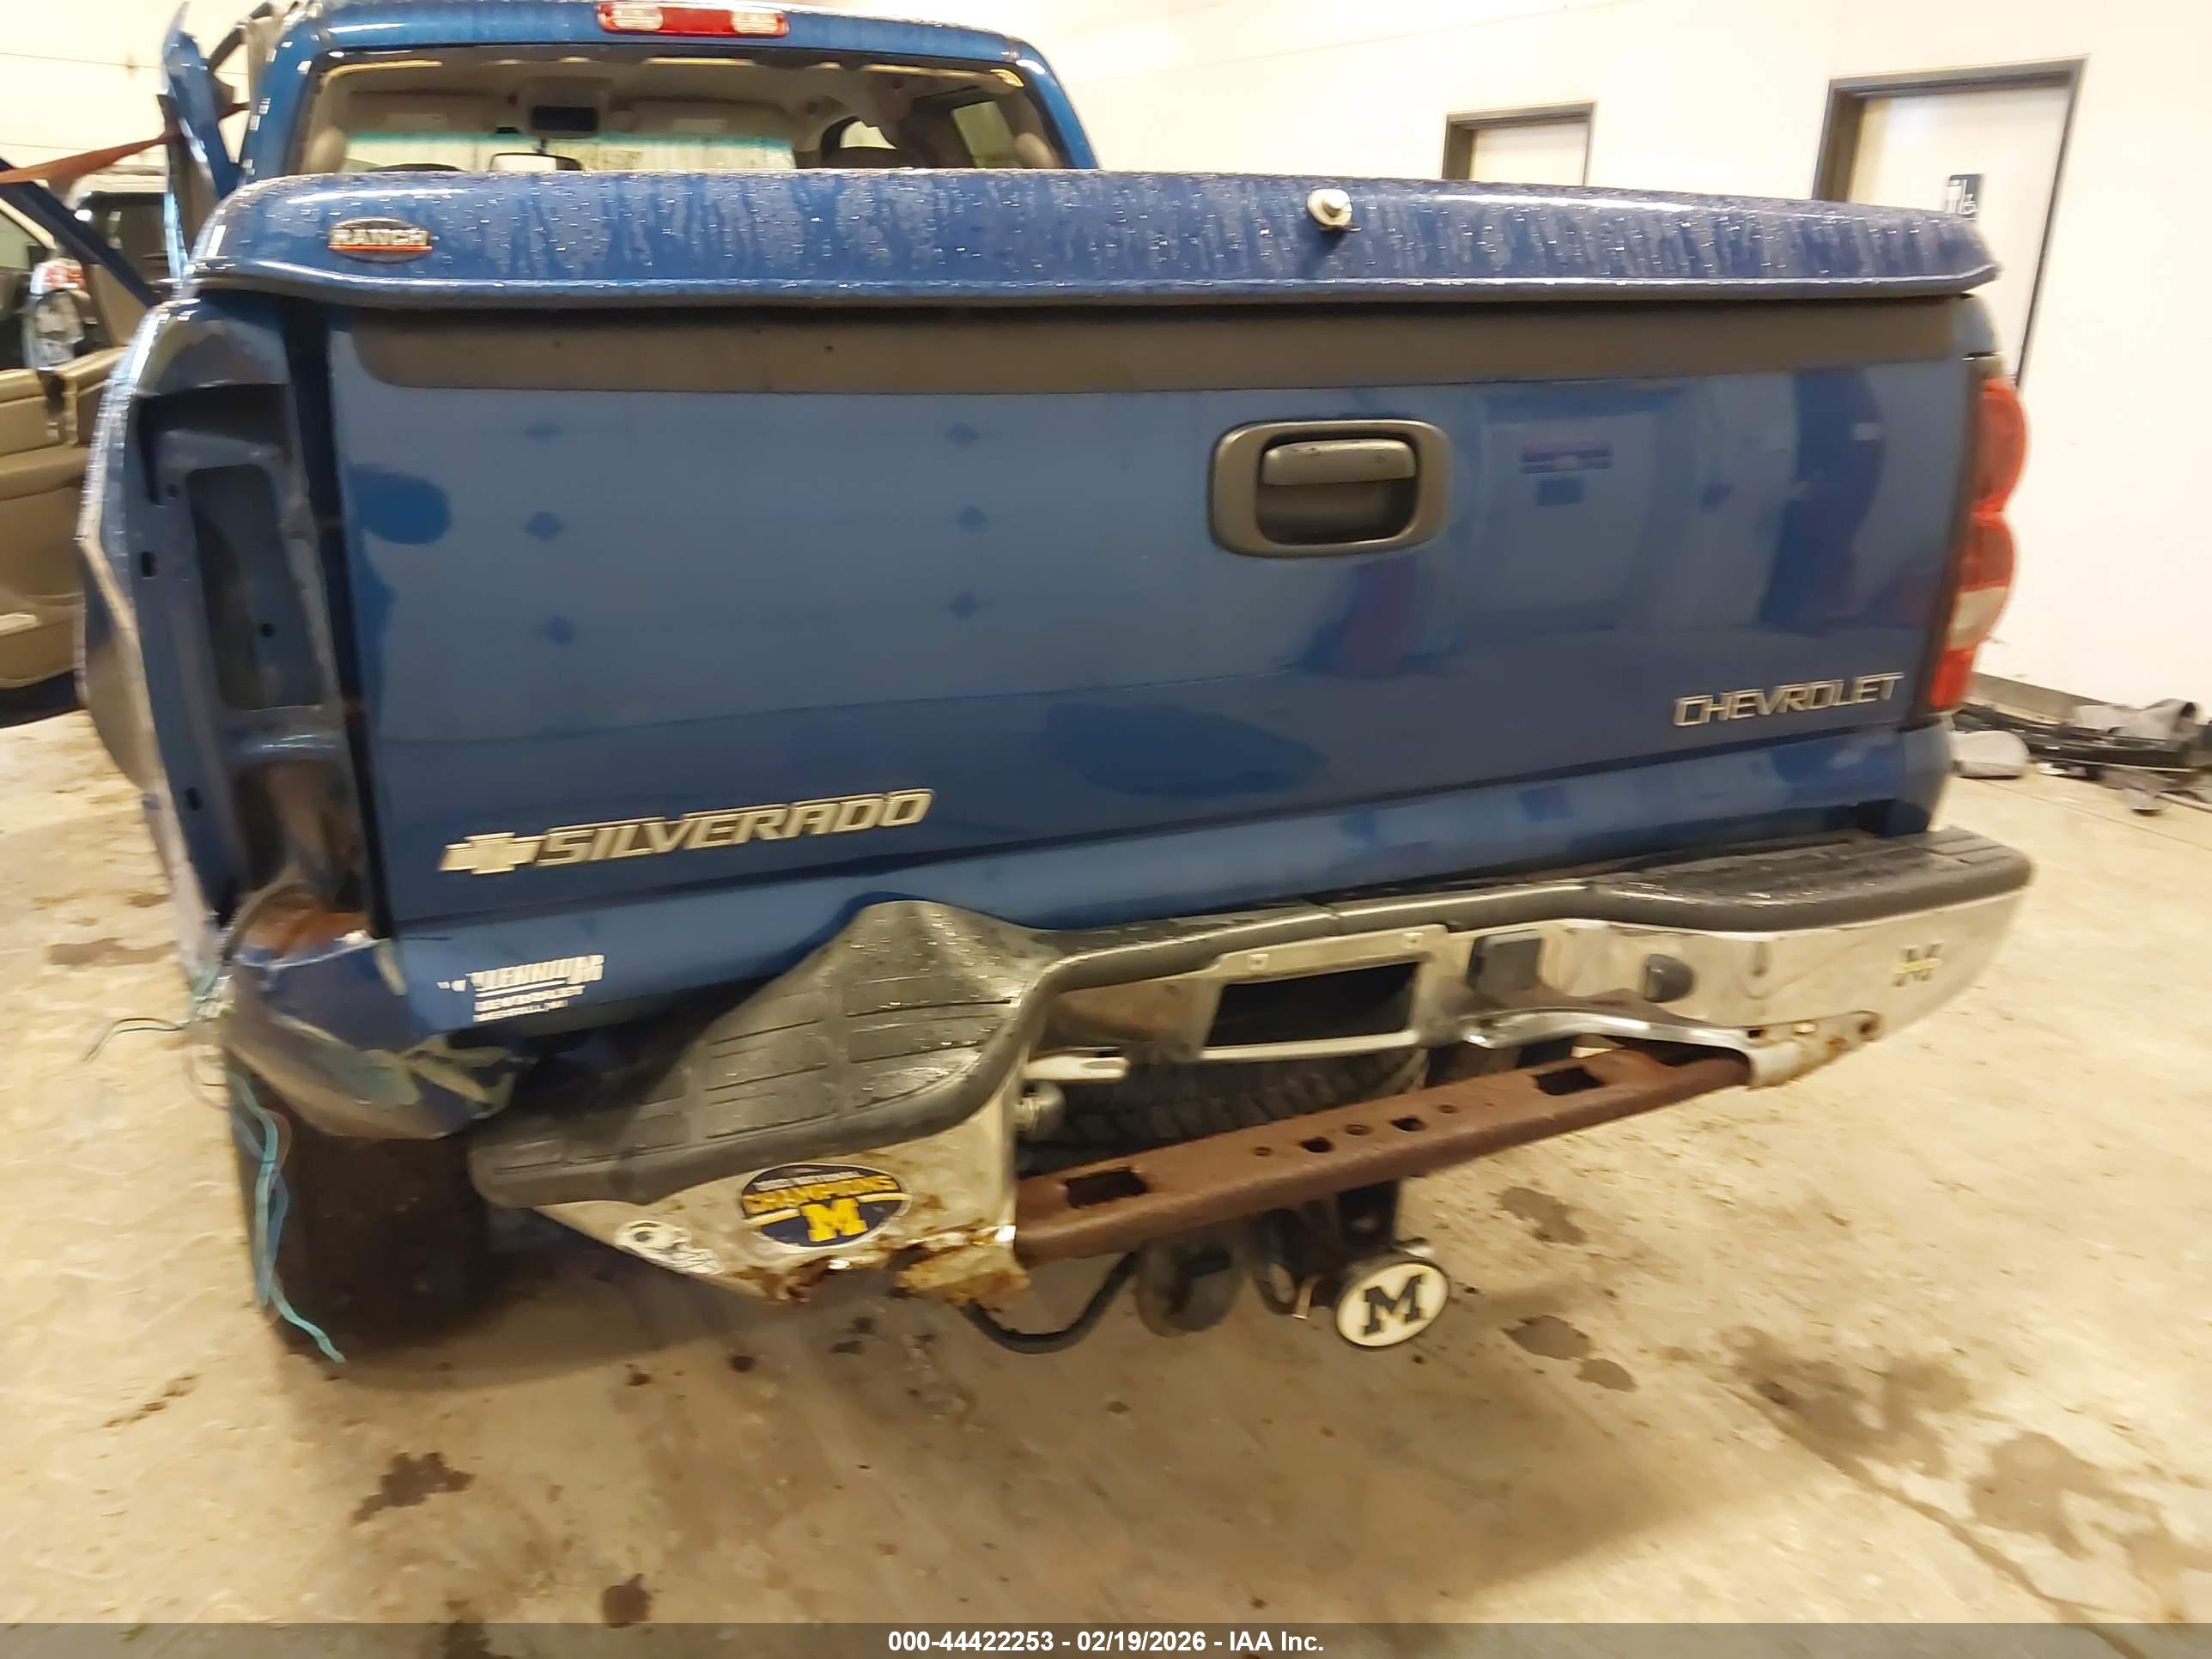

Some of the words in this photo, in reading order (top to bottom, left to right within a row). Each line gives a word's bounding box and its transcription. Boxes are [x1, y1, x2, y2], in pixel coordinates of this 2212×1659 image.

[1674, 672, 1905, 727] CHEVROLET
[534, 787, 934, 866] SILVERADO
[741, 1174, 901, 1215] CHAMPIONS
[799, 1197, 869, 1243] M
[1363, 1273, 1425, 1336] M
